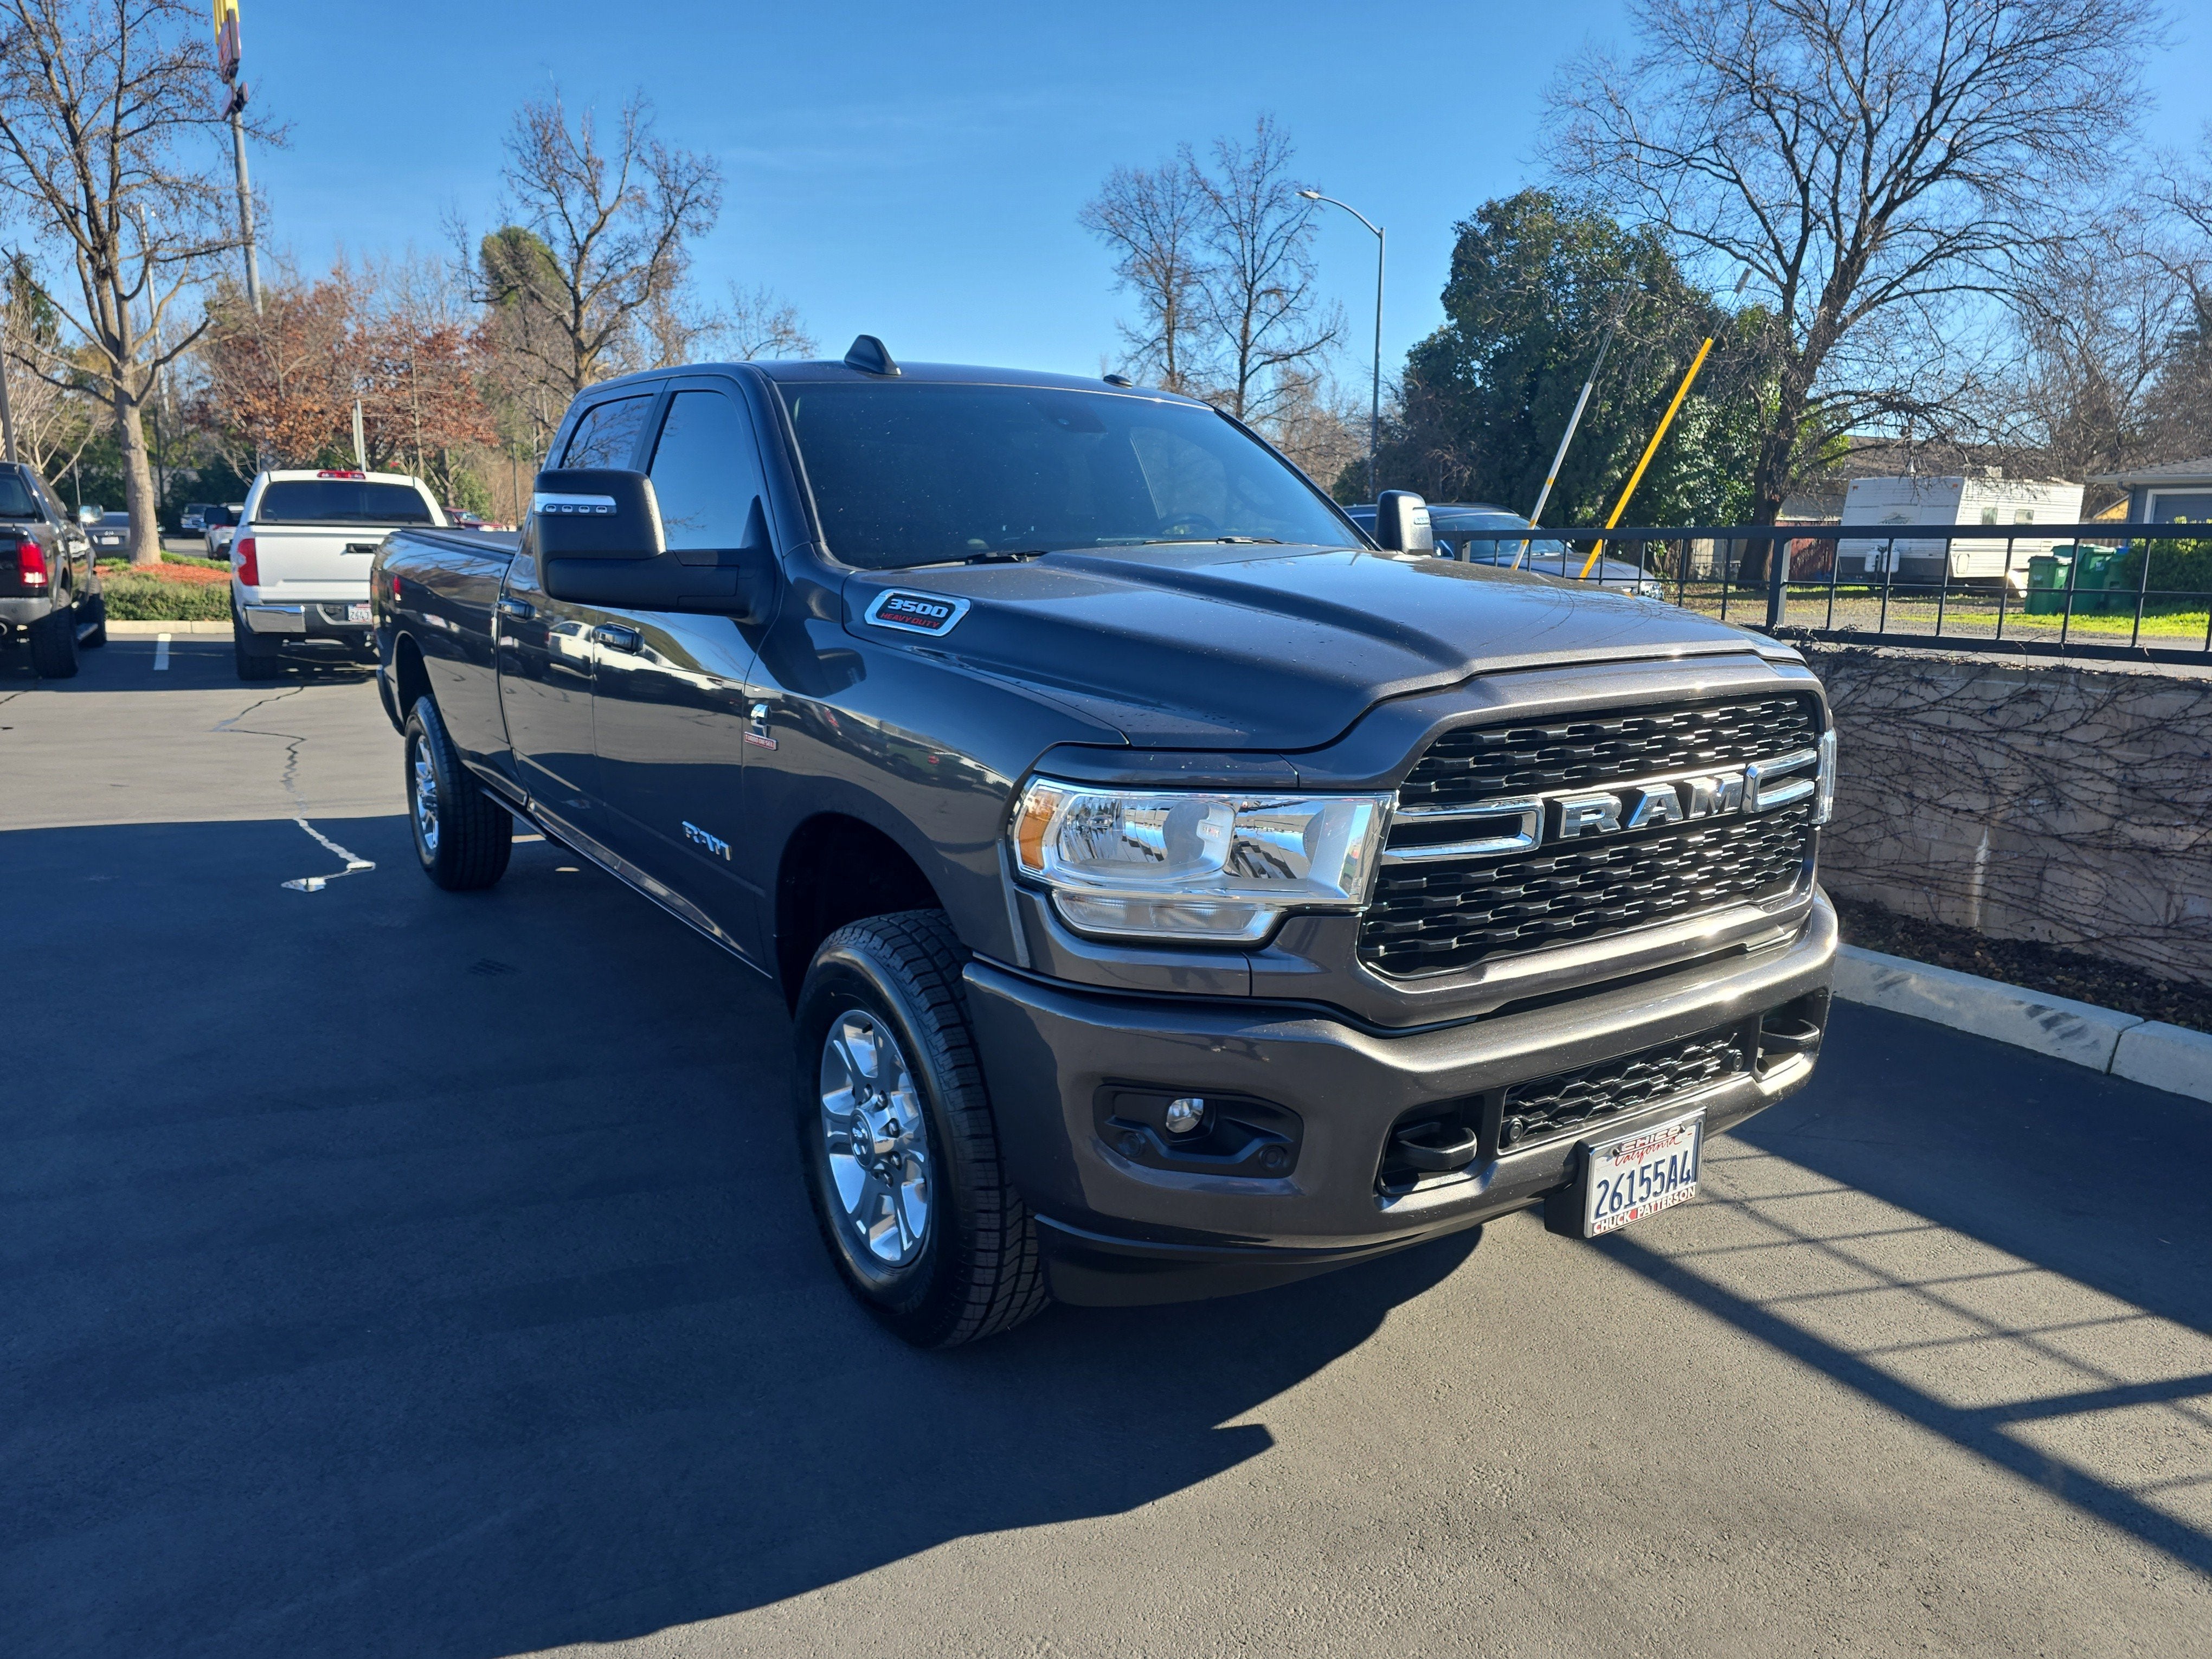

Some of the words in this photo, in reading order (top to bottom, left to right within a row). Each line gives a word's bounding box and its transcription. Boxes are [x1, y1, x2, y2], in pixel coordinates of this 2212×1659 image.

[880, 613, 912, 624] HEAVY
[911, 618, 940, 628] DUTY
[888, 599, 949, 618] 3500
[1553, 772, 1744, 839] RAM
[682, 821, 732, 861] RAM
[1621, 1125, 1681, 1152] CHICO
[1594, 1150, 1692, 1219] 26155A4
[1593, 1210, 1631, 1234] CHUCK
[1637, 1187, 1696, 1220] PATTERSON
